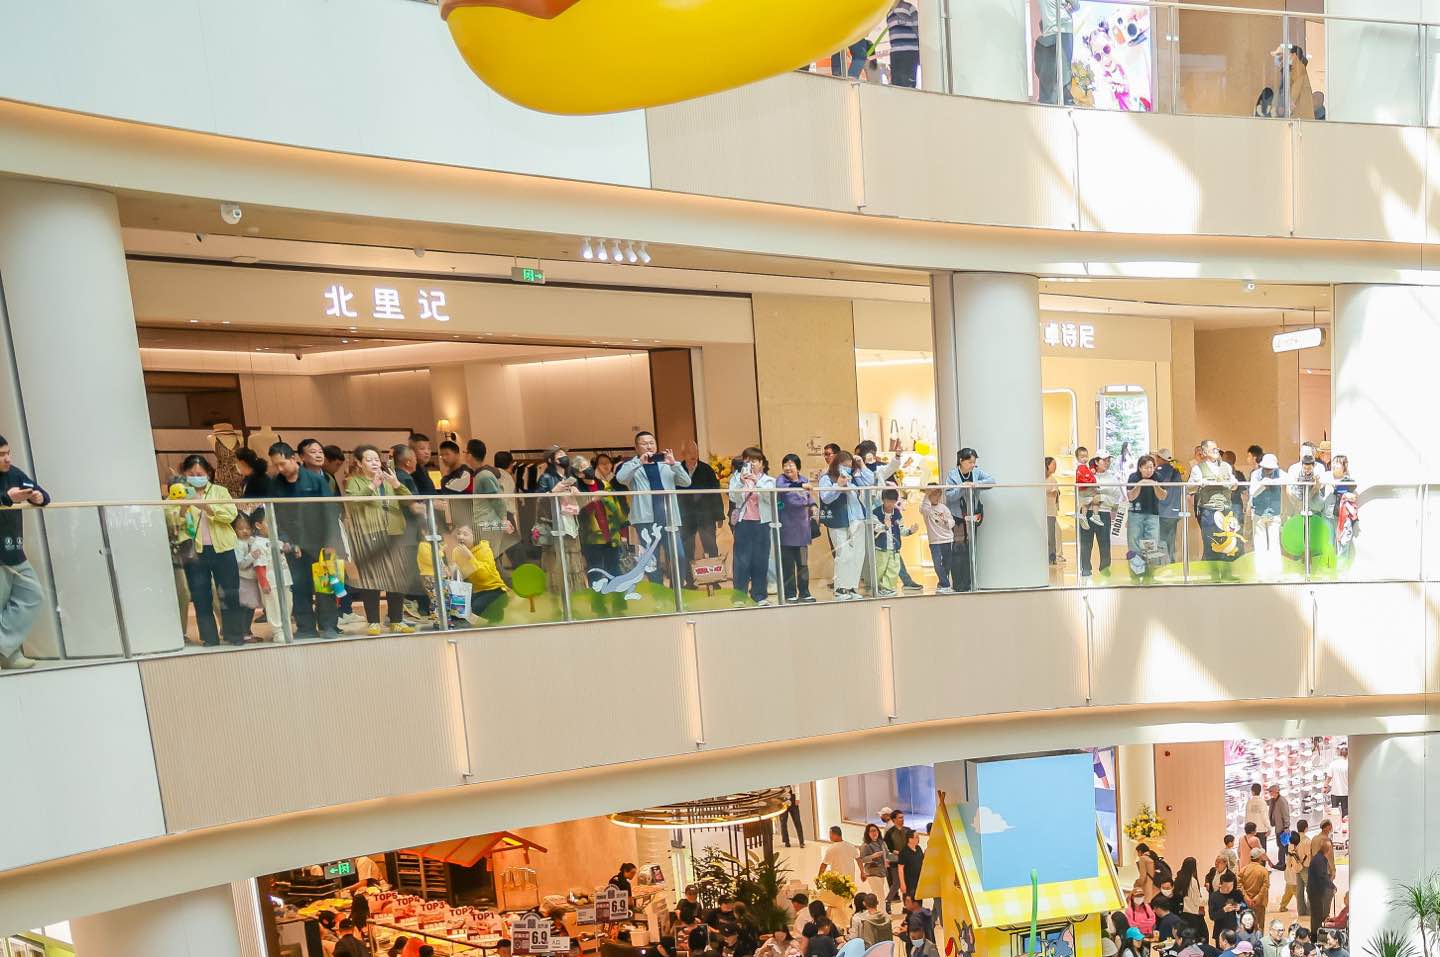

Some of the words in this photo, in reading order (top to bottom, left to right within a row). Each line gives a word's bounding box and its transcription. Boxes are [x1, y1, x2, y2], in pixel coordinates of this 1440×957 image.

[324, 285, 450, 321] 北里记
[421, 901, 445, 912] TOP3
[611, 900, 626, 913] 6.9
[471, 913, 495, 922] TOP1
[531, 930, 548, 945] 6.9
